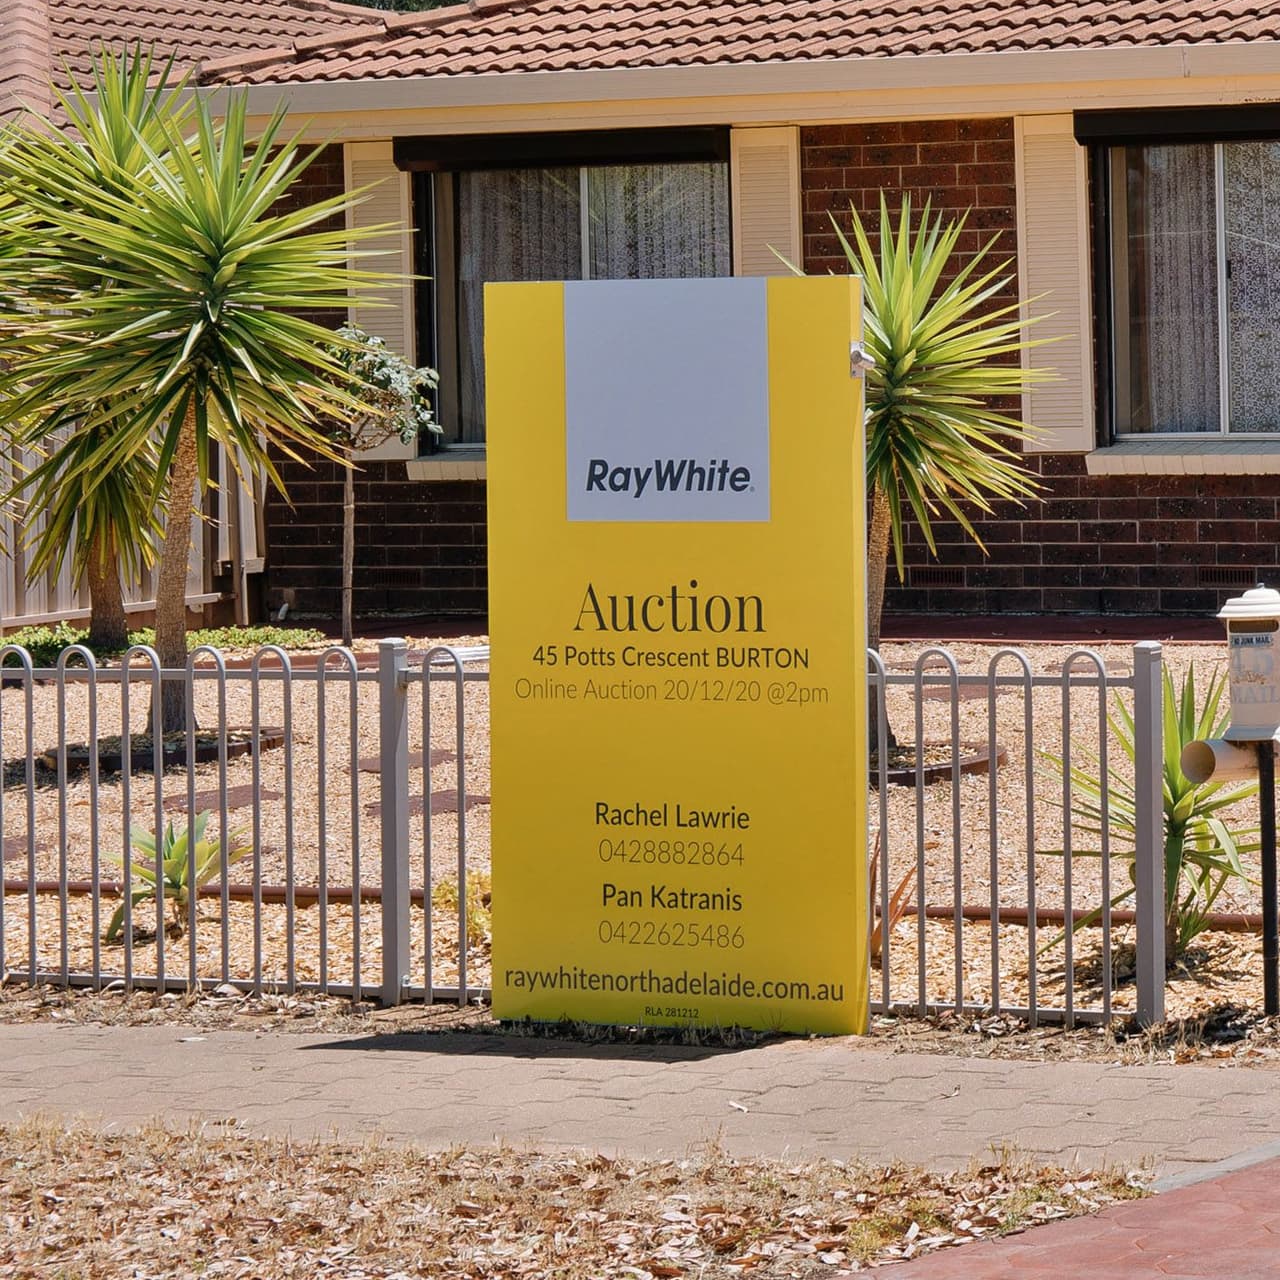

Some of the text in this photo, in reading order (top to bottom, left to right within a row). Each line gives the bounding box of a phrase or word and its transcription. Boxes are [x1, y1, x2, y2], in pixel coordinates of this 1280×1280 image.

[573, 579, 767, 633] Auction
[532, 646, 809, 669] 45 Potts Crescent BURTON
[514, 678, 829, 707] Online Auction 20/12/20 @2pm
[595, 802, 750, 830] Rachel Lawrie
[598, 839, 745, 867] 0428882864
[602, 883, 743, 911] Pan Katranis
[598, 920, 745, 949] 0422625486
[505, 965, 844, 1002] raywhitenorthadelaide.com.au
[645, 1005, 664, 1017] RLA
